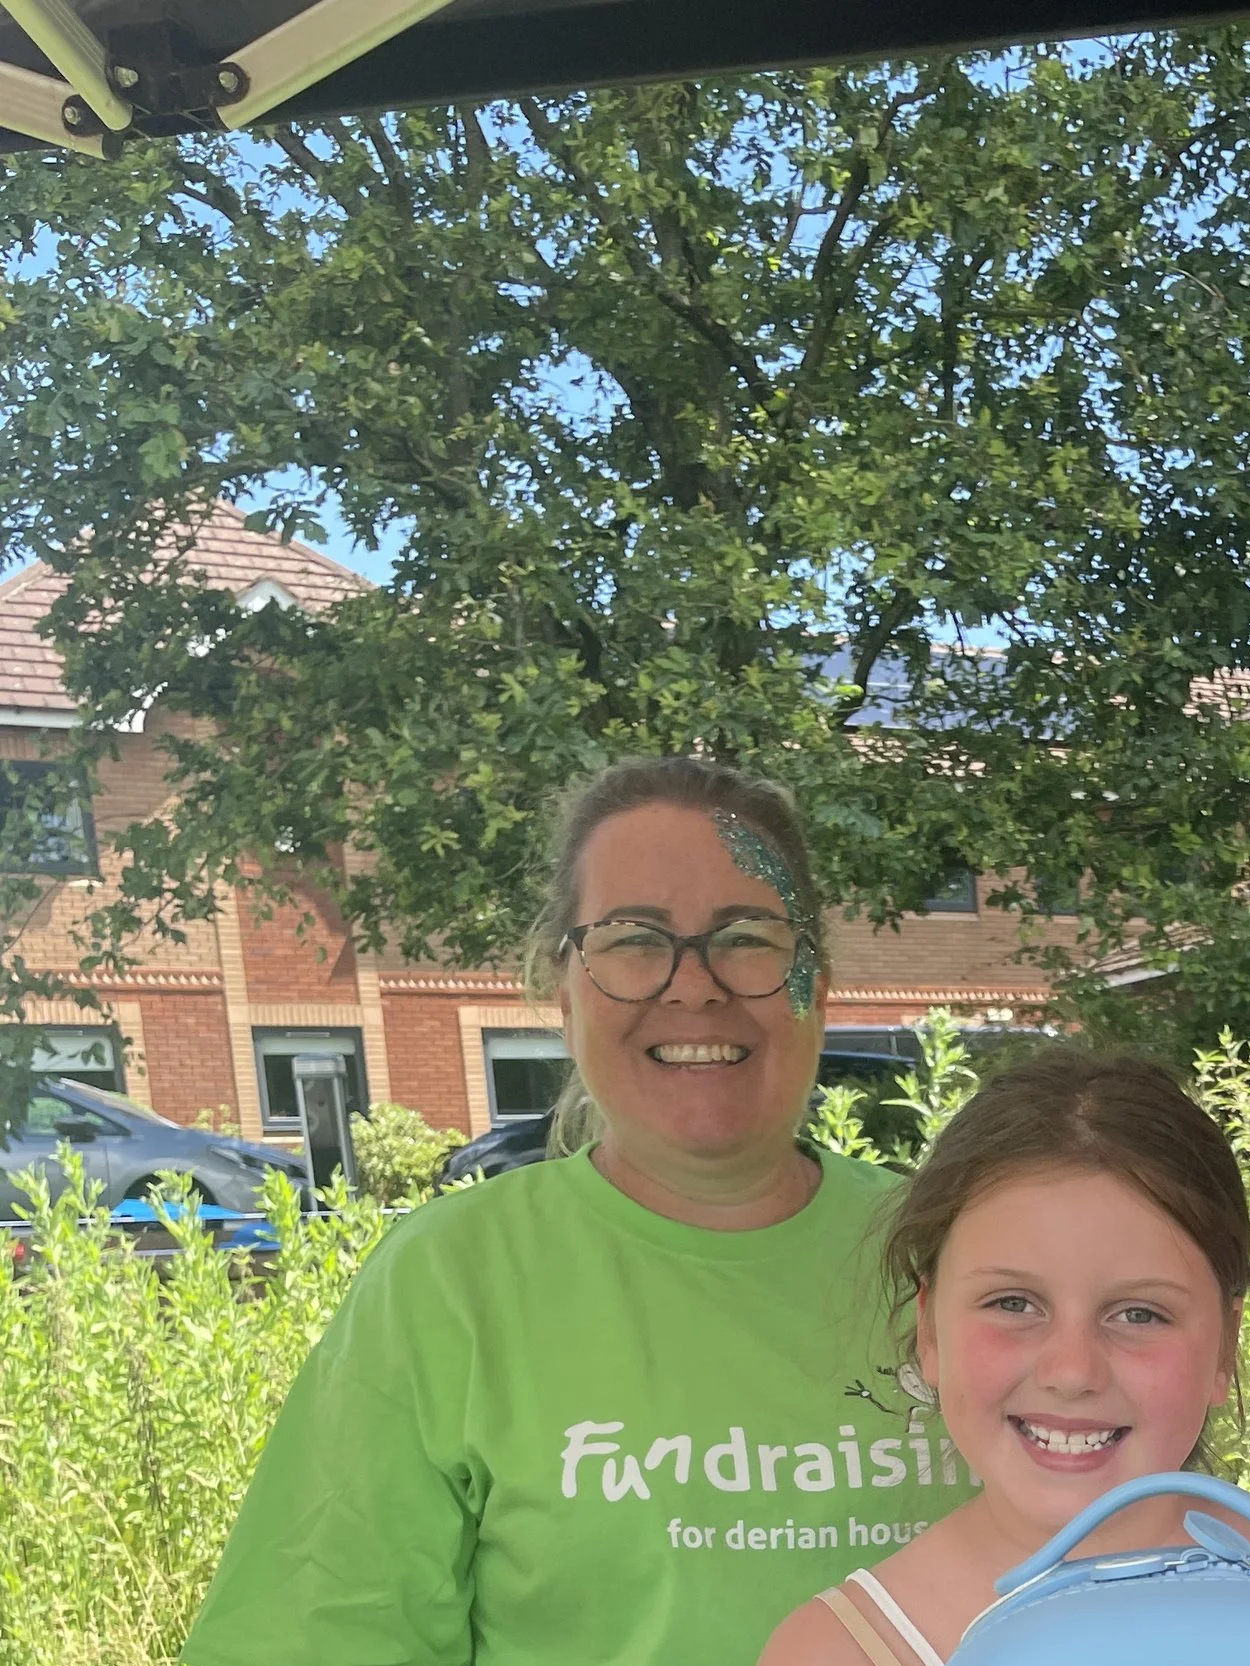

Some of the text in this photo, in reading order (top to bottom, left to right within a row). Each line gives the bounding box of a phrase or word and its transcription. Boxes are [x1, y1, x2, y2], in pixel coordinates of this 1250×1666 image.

[560, 1420, 983, 1502] Fundraisin
[667, 1517, 929, 1550] for derian hous
